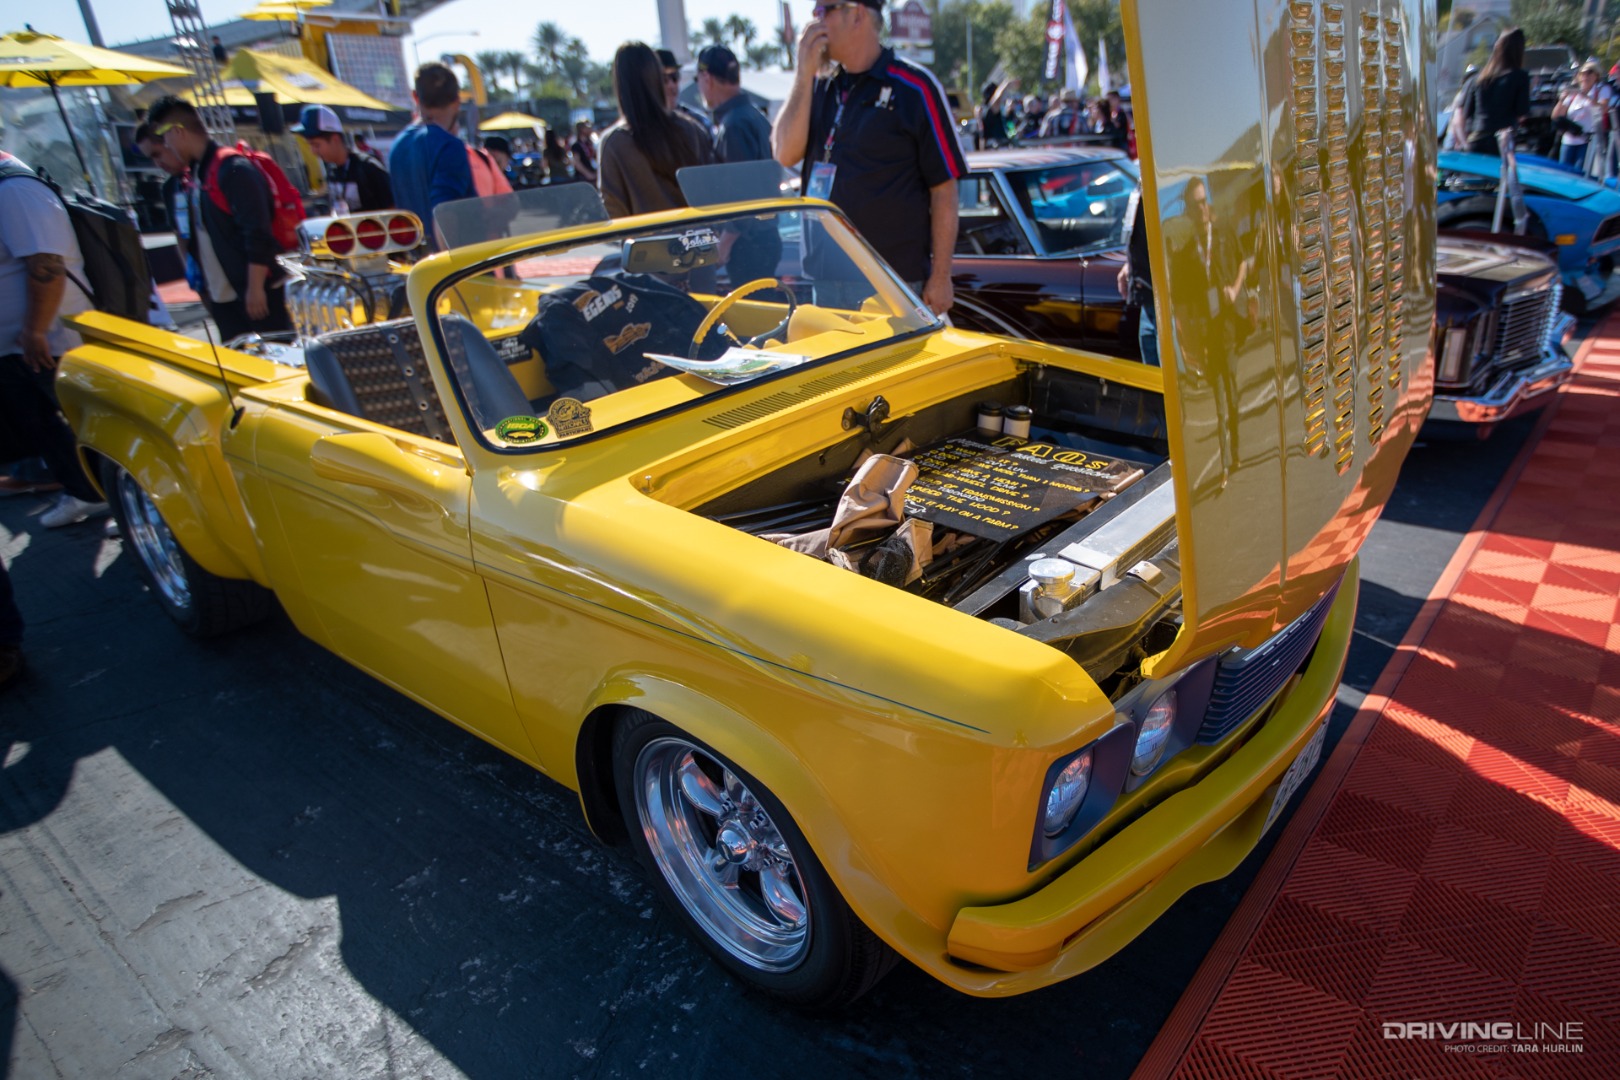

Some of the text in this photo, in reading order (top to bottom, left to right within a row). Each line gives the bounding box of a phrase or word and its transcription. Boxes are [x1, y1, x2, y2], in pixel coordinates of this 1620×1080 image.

[1008, 463, 1028, 474] LUV
[993, 466, 1018, 476] MORE
[1018, 473, 1041, 483] THAN
[1049, 481, 1083, 493] MOTOR
[993, 476, 1020, 487] HEMI
[938, 486, 986, 502] TORONADO
[990, 486, 1021, 497] DRIVE
[911, 485, 943, 497] UNDER
[946, 495, 967, 504] THE
[969, 501, 1000, 513] HOOD
[961, 488, 1032, 511] TRANSMISSION
[958, 510, 974, 518] ON
